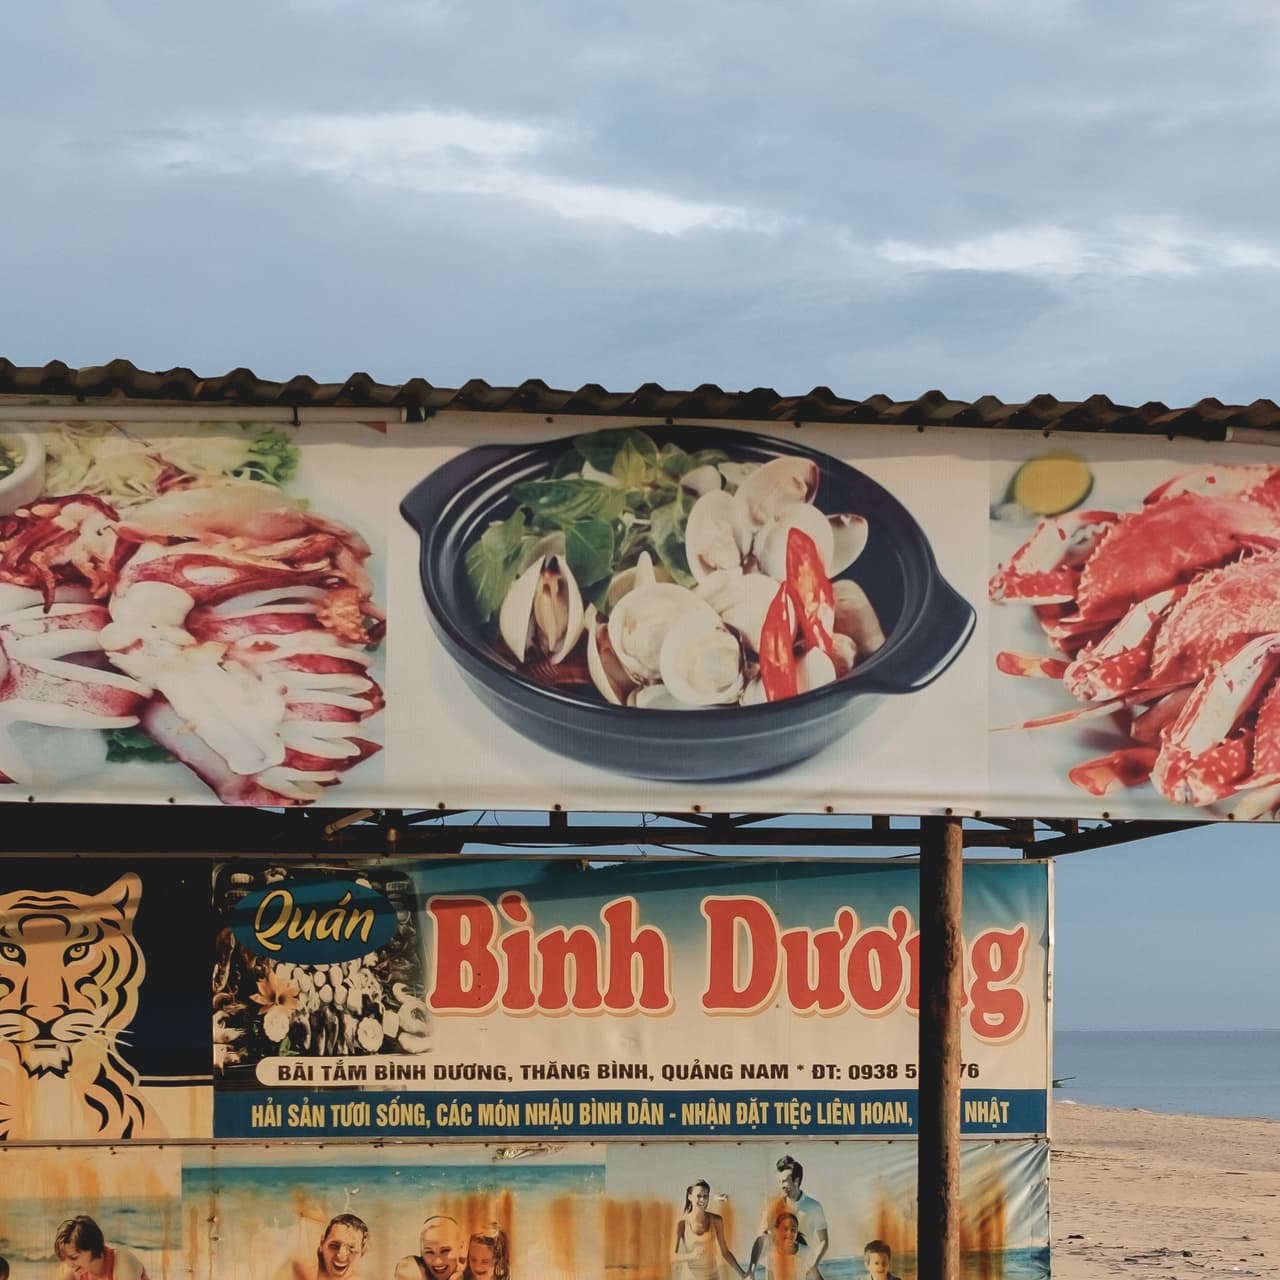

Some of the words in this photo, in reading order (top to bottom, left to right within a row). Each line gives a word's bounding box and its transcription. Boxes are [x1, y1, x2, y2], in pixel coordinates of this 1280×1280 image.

[254, 889, 375, 951] Quán
[428, 893, 674, 1012] Bình
[701, 897, 1027, 1040] Dươg
[278, 1062, 314, 1081] BÃI
[321, 1059, 367, 1081] TẮM
[374, 1061, 426, 1081] BÌNH
[433, 1062, 513, 1083] DƯƠNG,
[519, 1061, 590, 1081] THĂNG
[597, 1060, 654, 1082] BÌNH,
[661, 1058, 733, 1082] QUẢNG
[740, 1063, 789, 1080] NAM
[811, 1063, 841, 1080] ĐT:
[848, 1063, 898, 1080] 0938
[251, 1096, 282, 1128] HẢI
[287, 1096, 325, 1128] SẢN
[330, 1101, 371, 1127] TƯƠI
[376, 1095, 431, 1129] SỐNG,
[436, 1098, 473, 1127] CÁC
[478, 1098, 520, 1127] MÓN
[525, 1097, 574, 1130] NHẬU
[579, 1097, 622, 1126] BÌNH
[627, 1097, 664, 1126] DÂN
[681, 1097, 731, 1130] NHẬN
[736, 1097, 770, 1130] ĐẶT
[774, 1097, 812, 1130] TIỆC
[816, 1097, 856, 1126] LIÊN
[860, 1101, 913, 1127] HOAN,
[964, 1096, 1010, 1129] NHẬT
